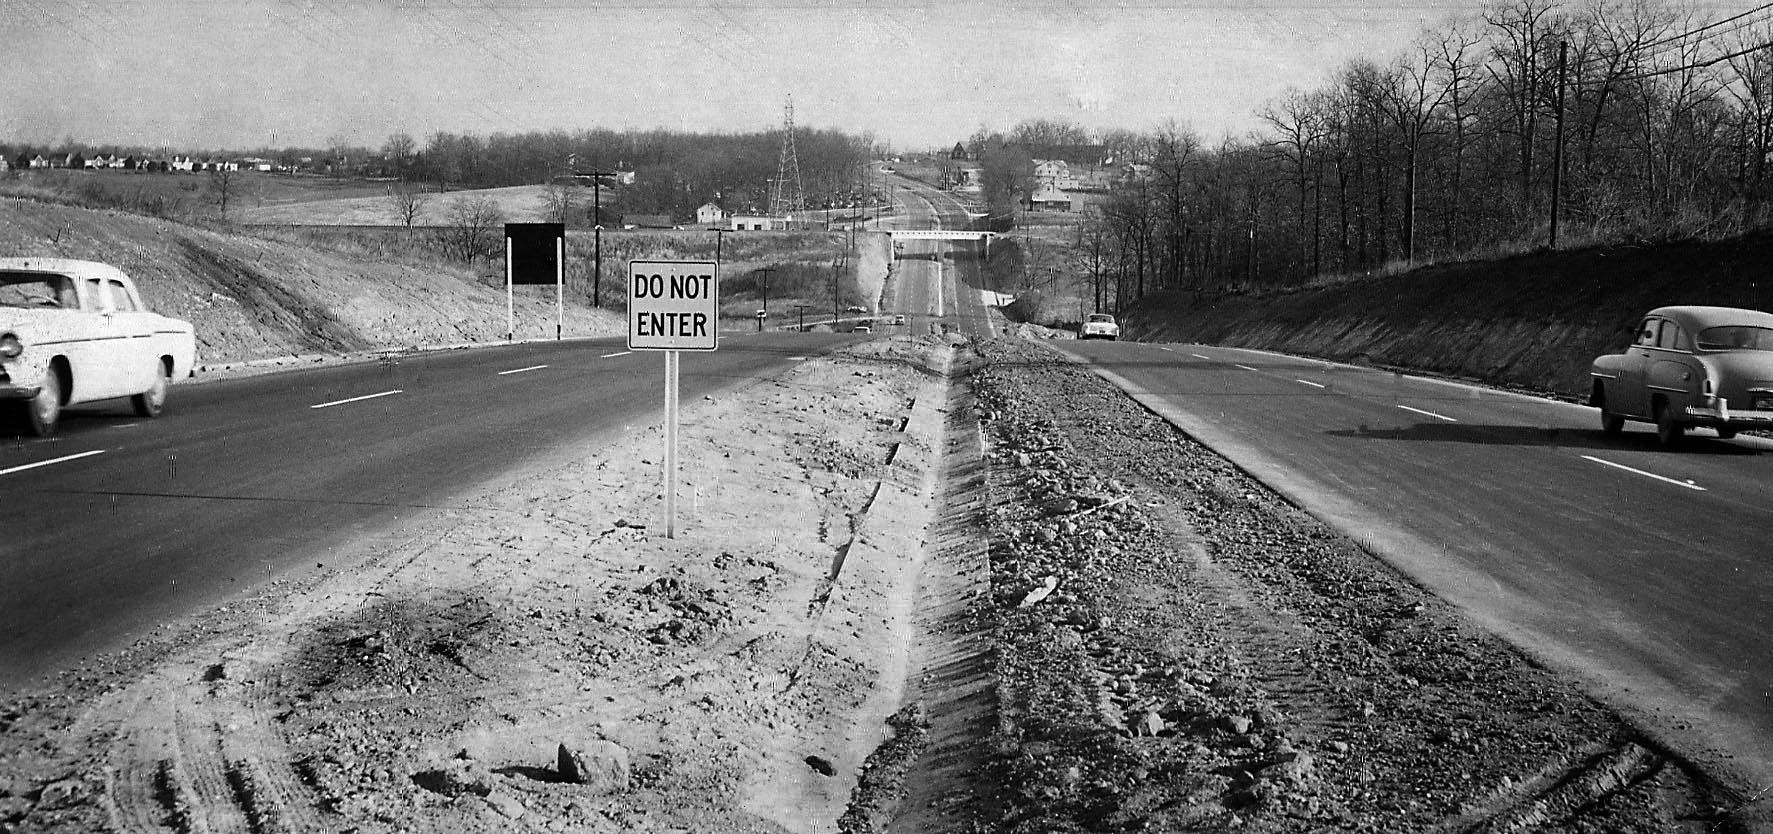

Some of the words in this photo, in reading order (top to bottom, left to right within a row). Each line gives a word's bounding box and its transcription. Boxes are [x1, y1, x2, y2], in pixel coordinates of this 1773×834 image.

[634, 274, 664, 299] DO
[670, 275, 712, 299] NOT
[637, 312, 707, 337] ENTER
